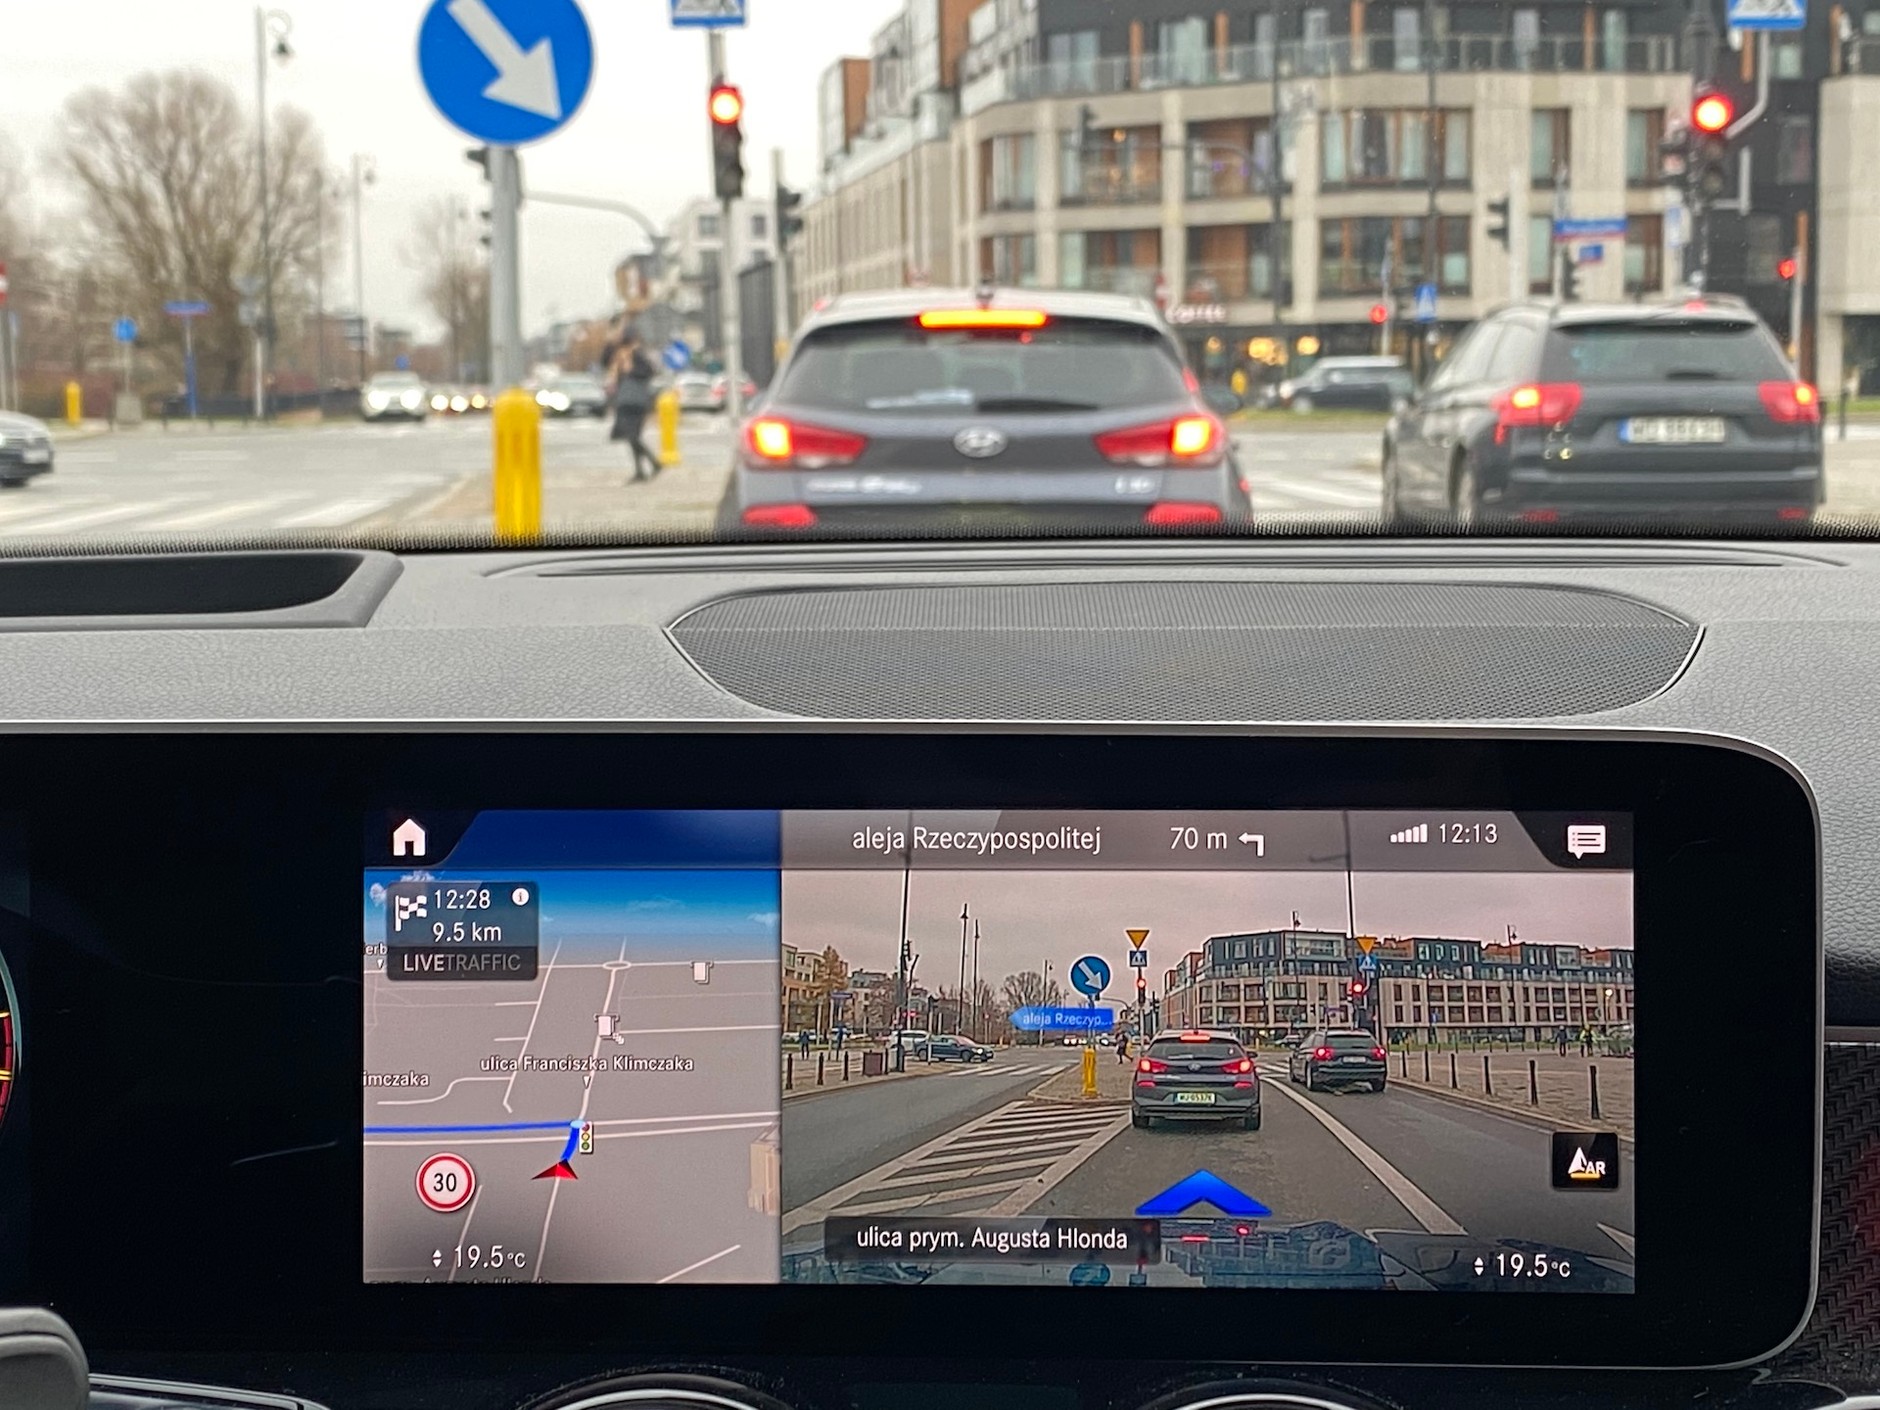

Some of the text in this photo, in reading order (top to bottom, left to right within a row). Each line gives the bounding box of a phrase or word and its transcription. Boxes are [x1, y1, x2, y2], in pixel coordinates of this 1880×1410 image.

[853, 826, 1100, 855] aleja Rzeczypospolitej
[1170, 827, 1228, 850] 70 m
[1439, 823, 1498, 844] 12:13
[434, 889, 491, 910] 12:28
[432, 922, 502, 942] 9.5 km
[403, 954, 521, 971] LIVETRAFFIC
[1023, 1012, 1051, 1027] aleja
[480, 1056, 695, 1072] ulica Franciszka Klimczaka
[1585, 1160, 1606, 1175] AR
[433, 1173, 458, 1193] 30
[857, 1225, 1128, 1253] ulica prym. Augusta Hlonda
